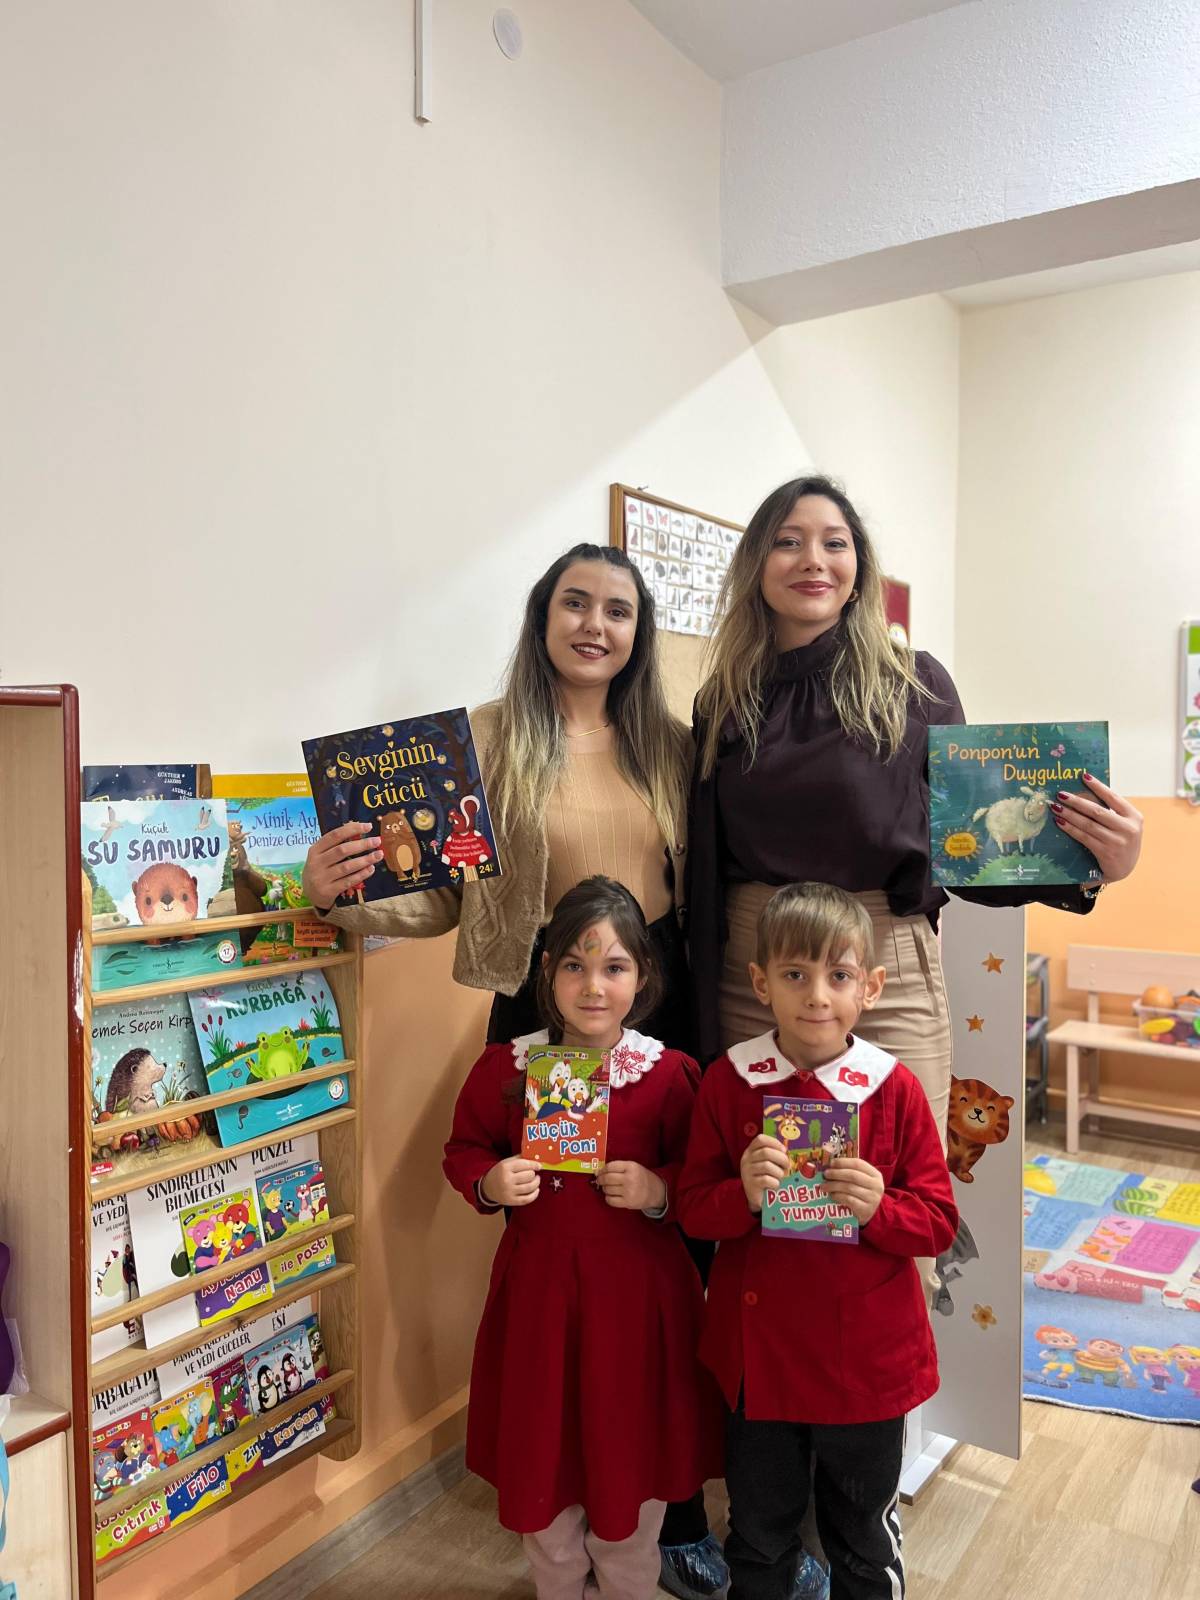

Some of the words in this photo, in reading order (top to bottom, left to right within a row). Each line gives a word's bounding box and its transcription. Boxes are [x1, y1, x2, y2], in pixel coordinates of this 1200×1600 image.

[336, 737, 437, 780] Sevginin
[948, 743, 1041, 767] Ponpon'un
[362, 776, 428, 809] Gücü
[141, 822, 170, 836] Küçük
[252, 808, 293, 830] Minik
[298, 811, 320, 835] Ay
[87, 839, 119, 866] SU
[127, 836, 221, 862] SAMURU
[248, 833, 284, 848] Denize
[285, 829, 321, 847] Gidiyo
[92, 1021, 125, 1039] emek
[129, 1017, 163, 1034] Seçen
[168, 1014, 193, 1030] Kirp
[527, 1122, 579, 1141] Küçük
[560, 1138, 597, 1155] Poni
[780, 1203, 853, 1223] Yumyum
[280, 1260, 295, 1273] ile
[224, 1268, 263, 1302] Nanu
[185, 1362, 196, 1376] VE
[217, 1332, 251, 1358] CÜCELER
[186, 1465, 219, 1500] Filo
[112, 1499, 162, 1542] Çıtırık
